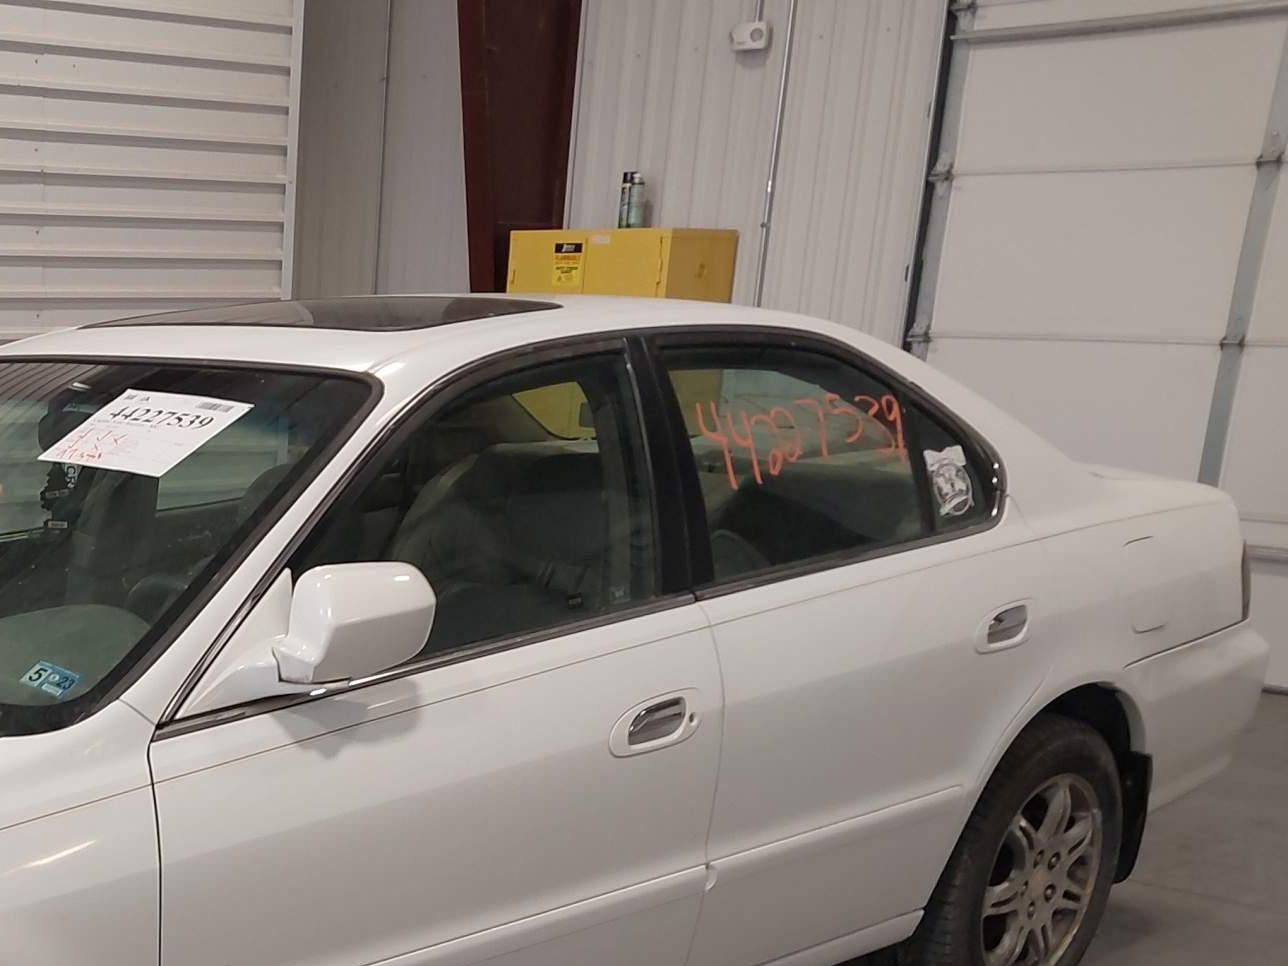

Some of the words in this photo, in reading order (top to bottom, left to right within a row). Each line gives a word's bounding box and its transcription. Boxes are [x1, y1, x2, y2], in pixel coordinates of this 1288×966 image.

[109, 404, 215, 429] 44227539
[695, 392, 909, 491] 44227539
[28, 667, 48, 682] 5
